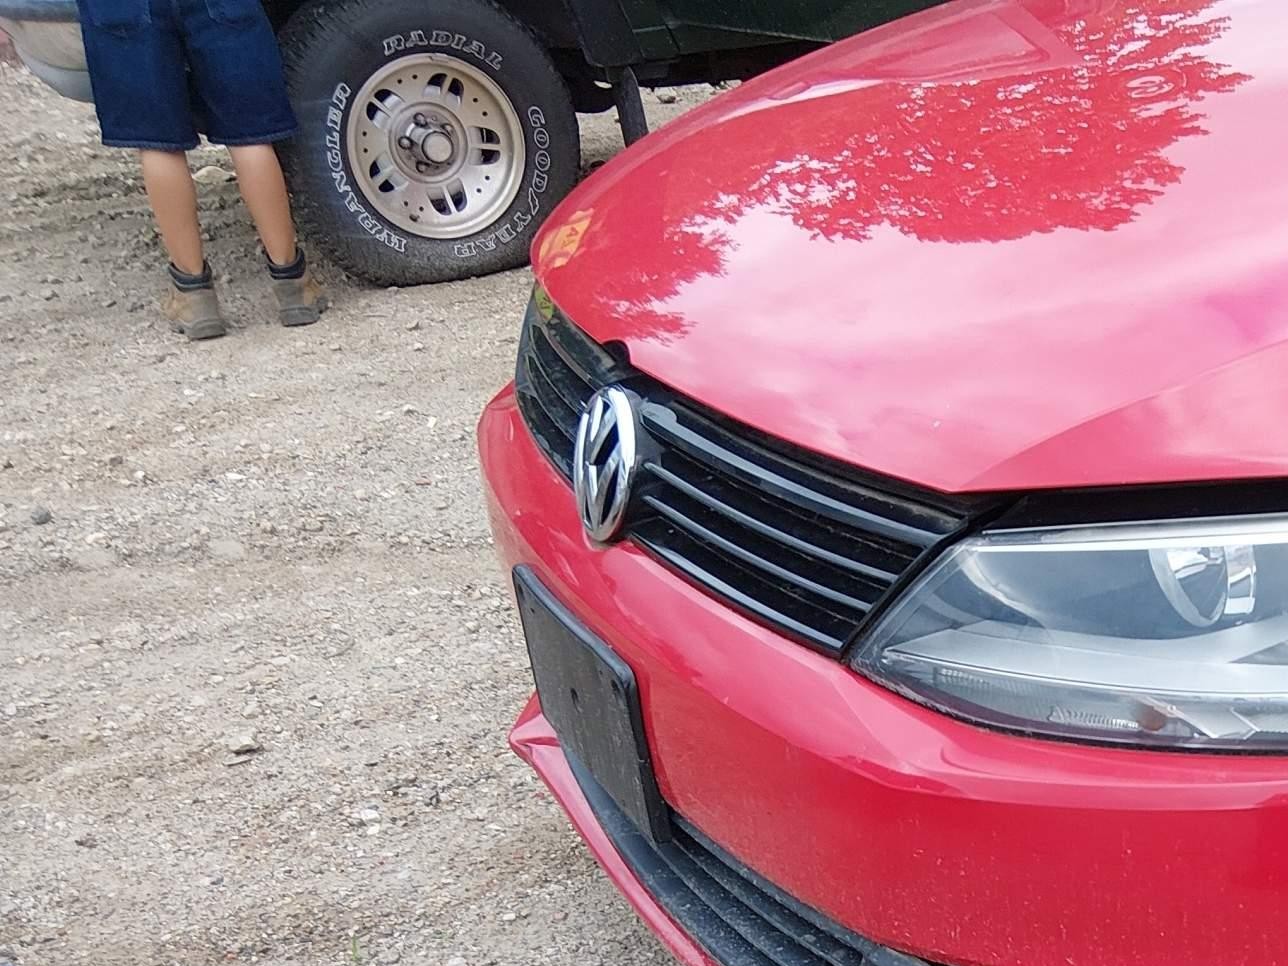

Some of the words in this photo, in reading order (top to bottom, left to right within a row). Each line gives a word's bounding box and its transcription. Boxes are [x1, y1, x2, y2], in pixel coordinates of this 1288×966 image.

[383, 30, 503, 70] RADIAL
[326, 82, 407, 253] WRANGLER
[454, 106, 550, 258] GOODYEAR
